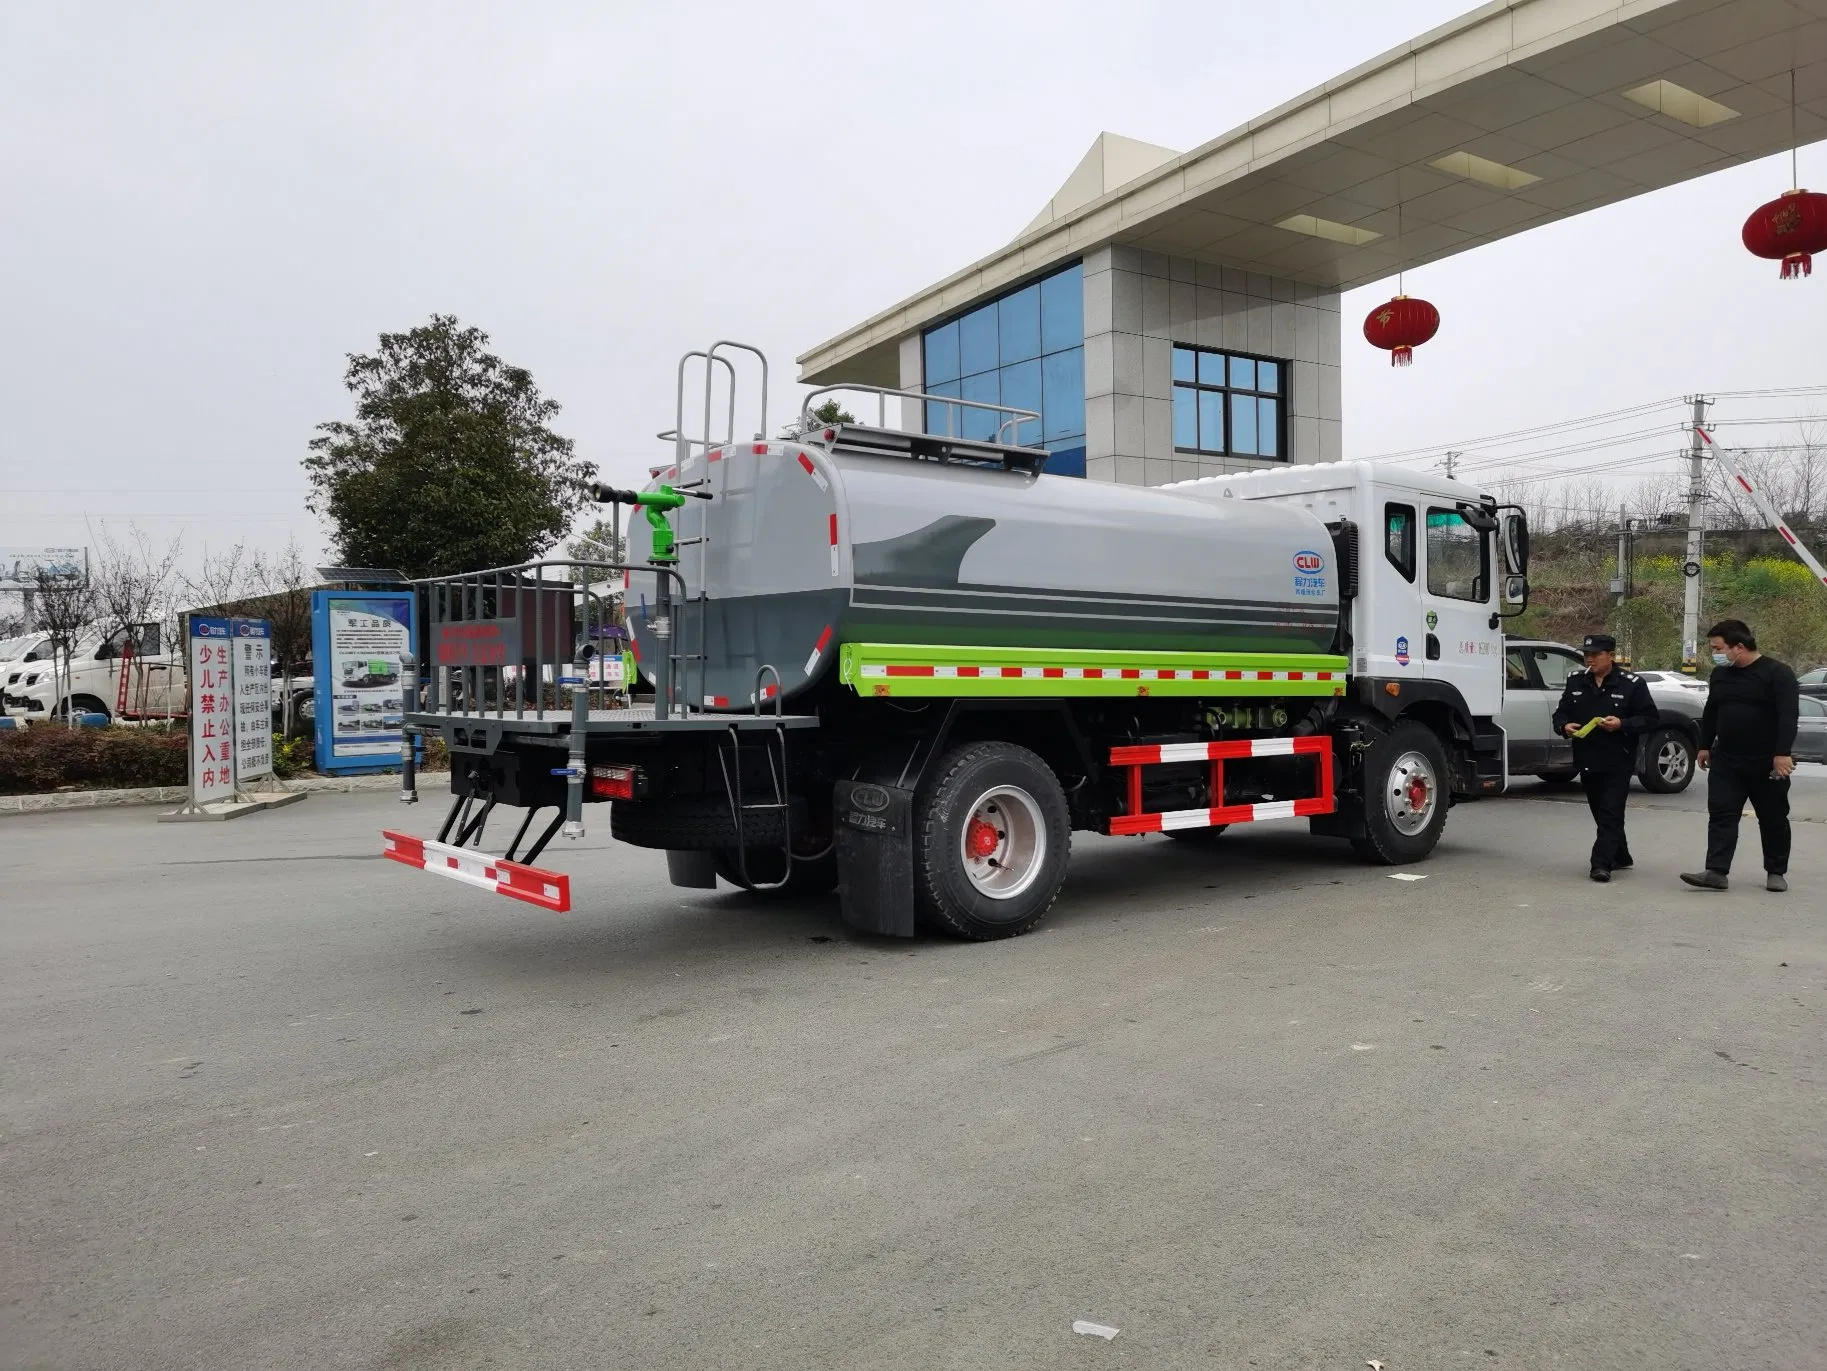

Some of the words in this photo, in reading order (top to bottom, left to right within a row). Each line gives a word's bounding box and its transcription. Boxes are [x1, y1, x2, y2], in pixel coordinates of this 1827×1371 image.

[1296, 556, 1320, 569] CLW
[1294, 576, 1325, 588] 程力汽车
[348, 619, 392, 628] 军工品质
[244, 644, 264, 660] 警示
[200, 644, 216, 788] 少儿禁止入内
[216, 646, 230, 785] 生产办公重地
